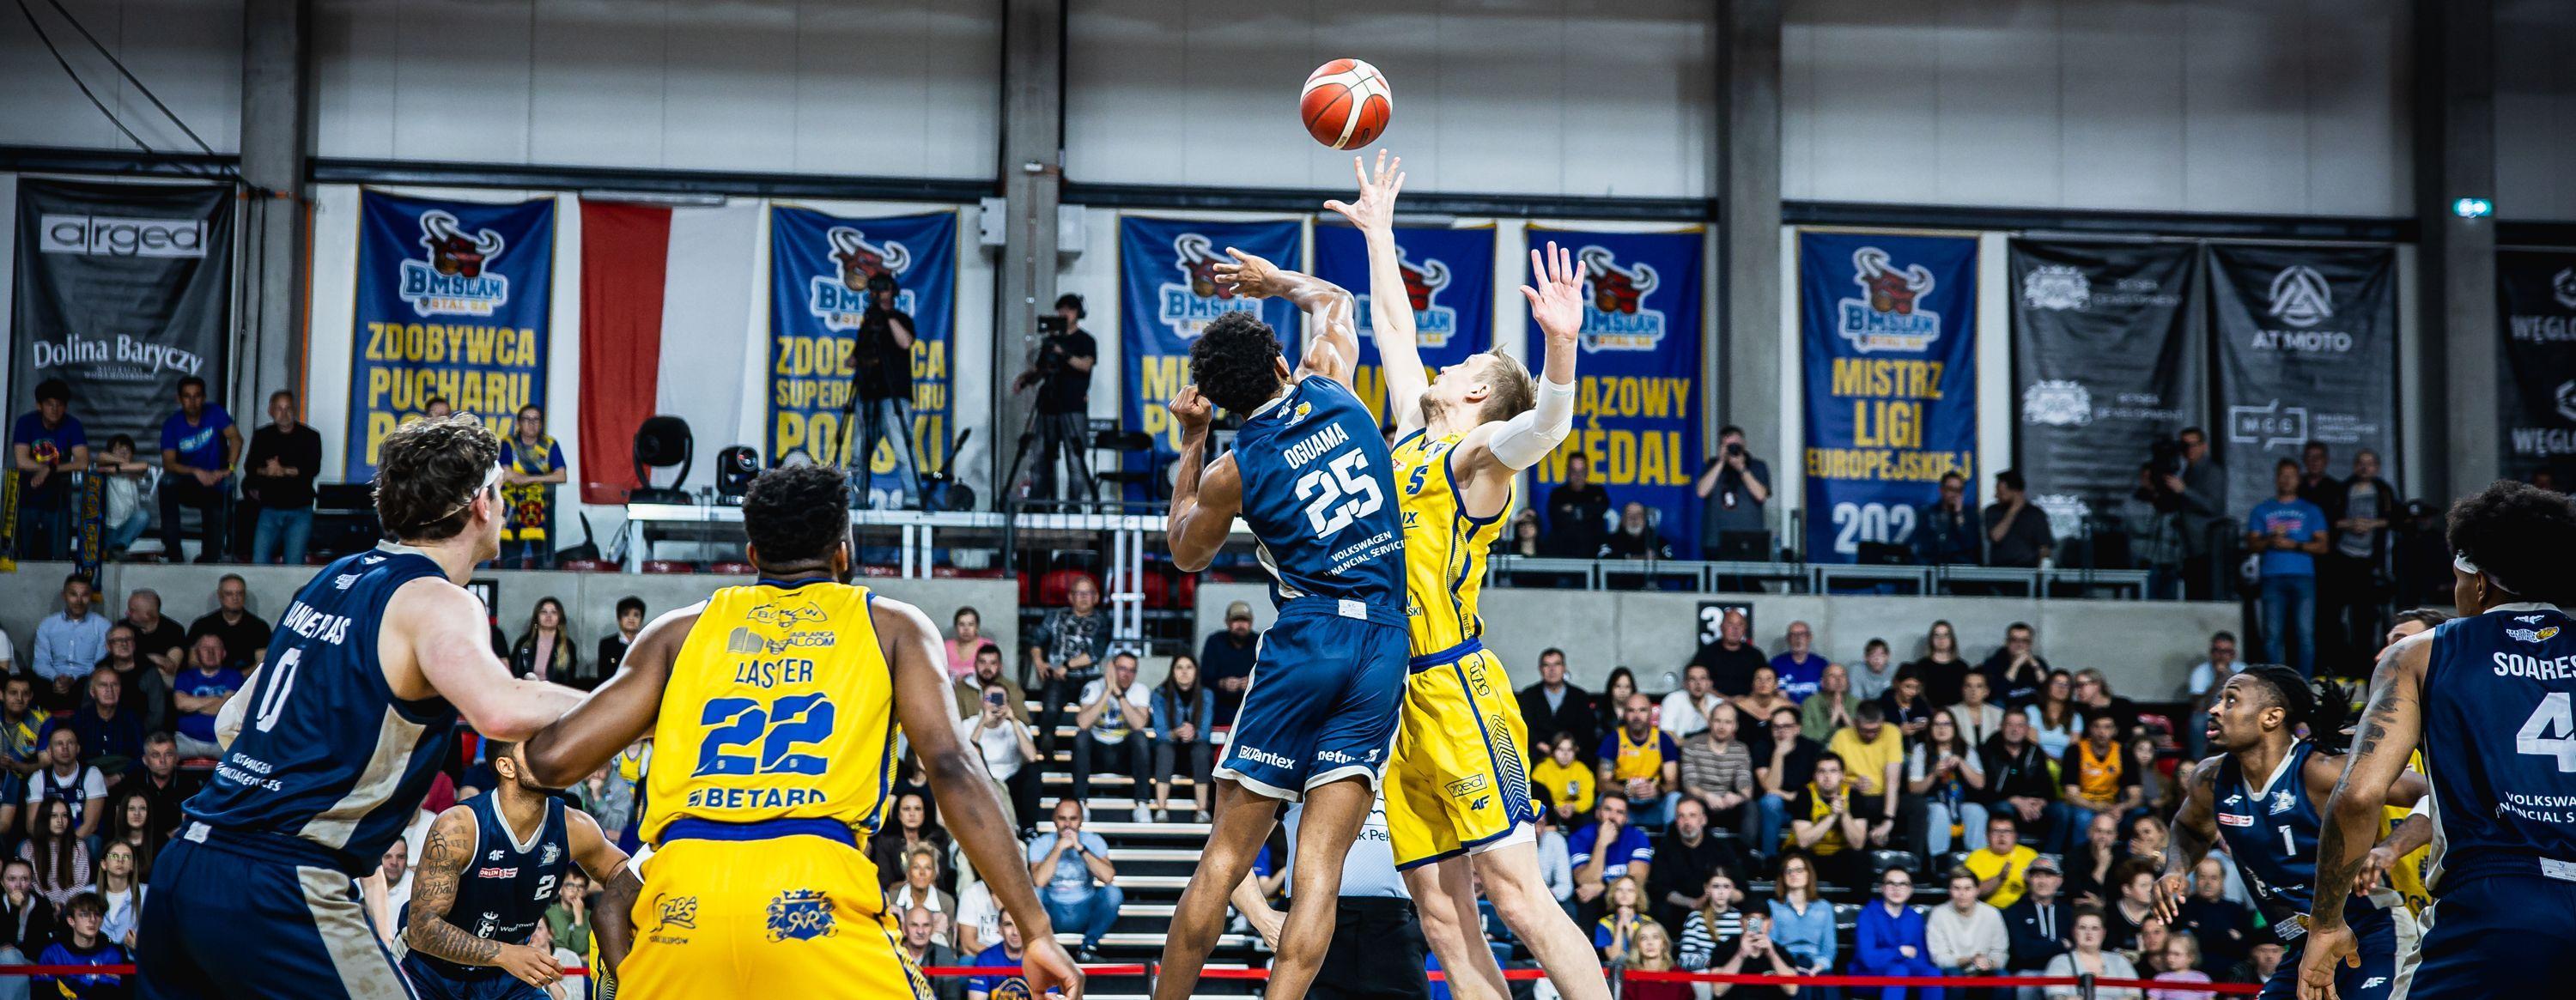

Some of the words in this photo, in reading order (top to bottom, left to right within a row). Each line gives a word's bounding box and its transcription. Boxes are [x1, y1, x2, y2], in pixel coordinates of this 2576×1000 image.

[50, 219, 202, 256] arged
[405, 266, 503, 297] BMSLAM
[33, 333, 108, 370] Dolina
[116, 334, 204, 375] Baryczy
[366, 322, 537, 367] ZDOBYWCA
[776, 336, 946, 379] ZDOBCA
[368, 367, 531, 414] PUCHARU
[1832, 358, 1944, 399] MISTRZ
[1853, 400, 1923, 448] LIGI
[1283, 421, 1351, 470] OGUAMA
[1807, 447, 1971, 482] EUROPEJSKIEJ
[1295, 446, 1384, 540] 25
[1331, 530, 1393, 562] VOLKSWAGEN
[256, 647, 302, 733] 0
[1469, 660, 1491, 696] STAL
[690, 692, 835, 778] 22
[2516, 692, 2576, 773] 4
[705, 787, 827, 808] BETARD
[2278, 825, 2297, 856] 1
[533, 875, 556, 900] 2
